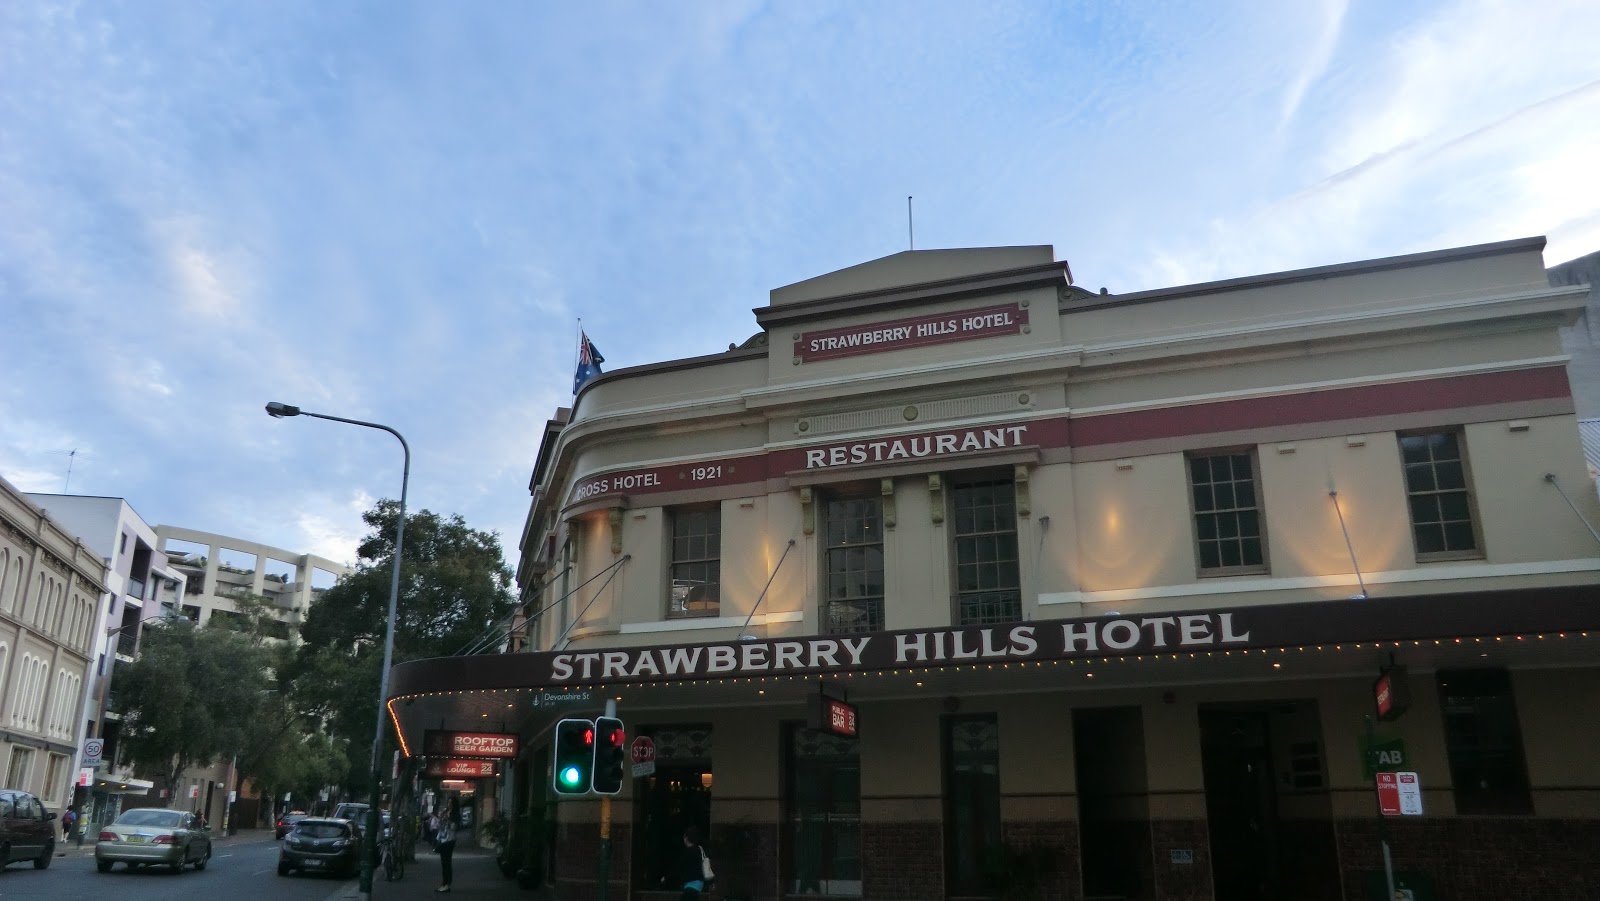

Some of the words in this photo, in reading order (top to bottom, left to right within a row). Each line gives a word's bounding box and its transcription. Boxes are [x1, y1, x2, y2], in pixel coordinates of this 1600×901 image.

[810, 326, 913, 352] STRAWBERRY
[917, 319, 957, 337] HILLS
[962, 312, 1013, 331] HOTEL
[806, 425, 1027, 469] RESTAURANT
[576, 479, 609, 501] CROSS
[613, 473, 661, 490] HOTEL
[691, 465, 722, 481] 1921
[551, 636, 872, 680] STRAWBERRY
[894, 626, 1038, 663] HILLS
[1061, 613, 1250, 652] HOTEL
[544, 693, 581, 701] Devonshire
[582, 692, 590, 700] St
[832, 714, 845, 728] BAR
[454, 736, 514, 747] ROOFTOP
[88, 745, 99, 753] 50
[454, 744, 477, 752] BEER
[478, 745, 513, 753] GARDEN
[633, 746, 654, 758] STOP
